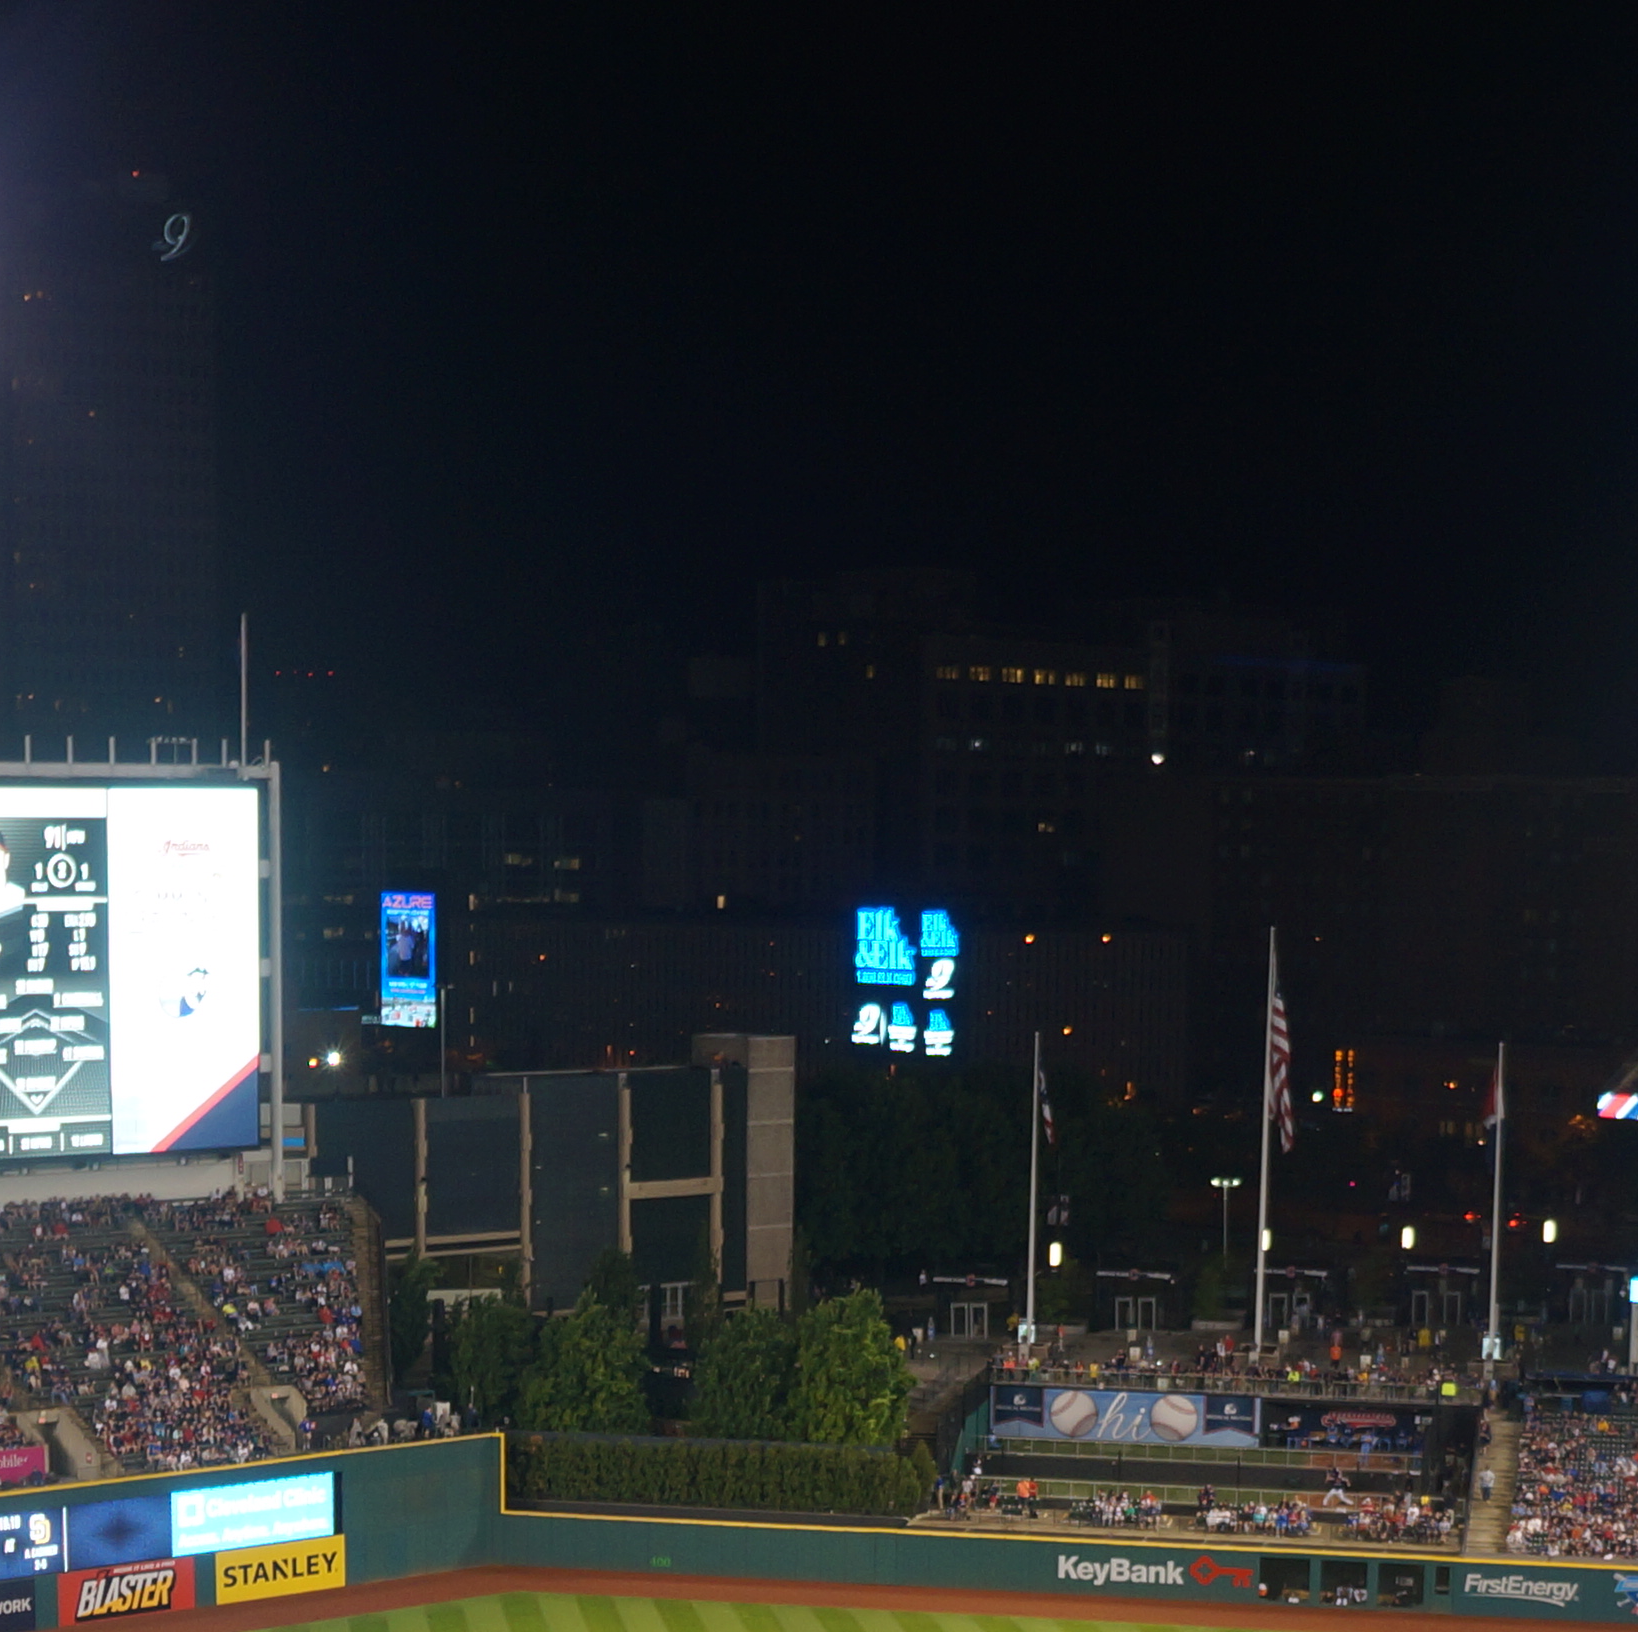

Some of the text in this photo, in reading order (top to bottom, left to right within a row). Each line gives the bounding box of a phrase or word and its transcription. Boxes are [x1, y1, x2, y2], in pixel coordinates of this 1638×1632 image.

[382, 895, 433, 909] AZURE
[857, 908, 899, 941] Elk
[921, 911, 950, 932] Elk
[855, 937, 917, 970] &Elk
[206, 1485, 327, 1518] Cleveland Clinic
[223, 1551, 335, 1587] STANLEY
[1057, 1555, 1184, 1586] KeyBank
[77, 1567, 175, 1617] BLASTER
[1464, 1573, 1578, 1602] FirstEnergy
